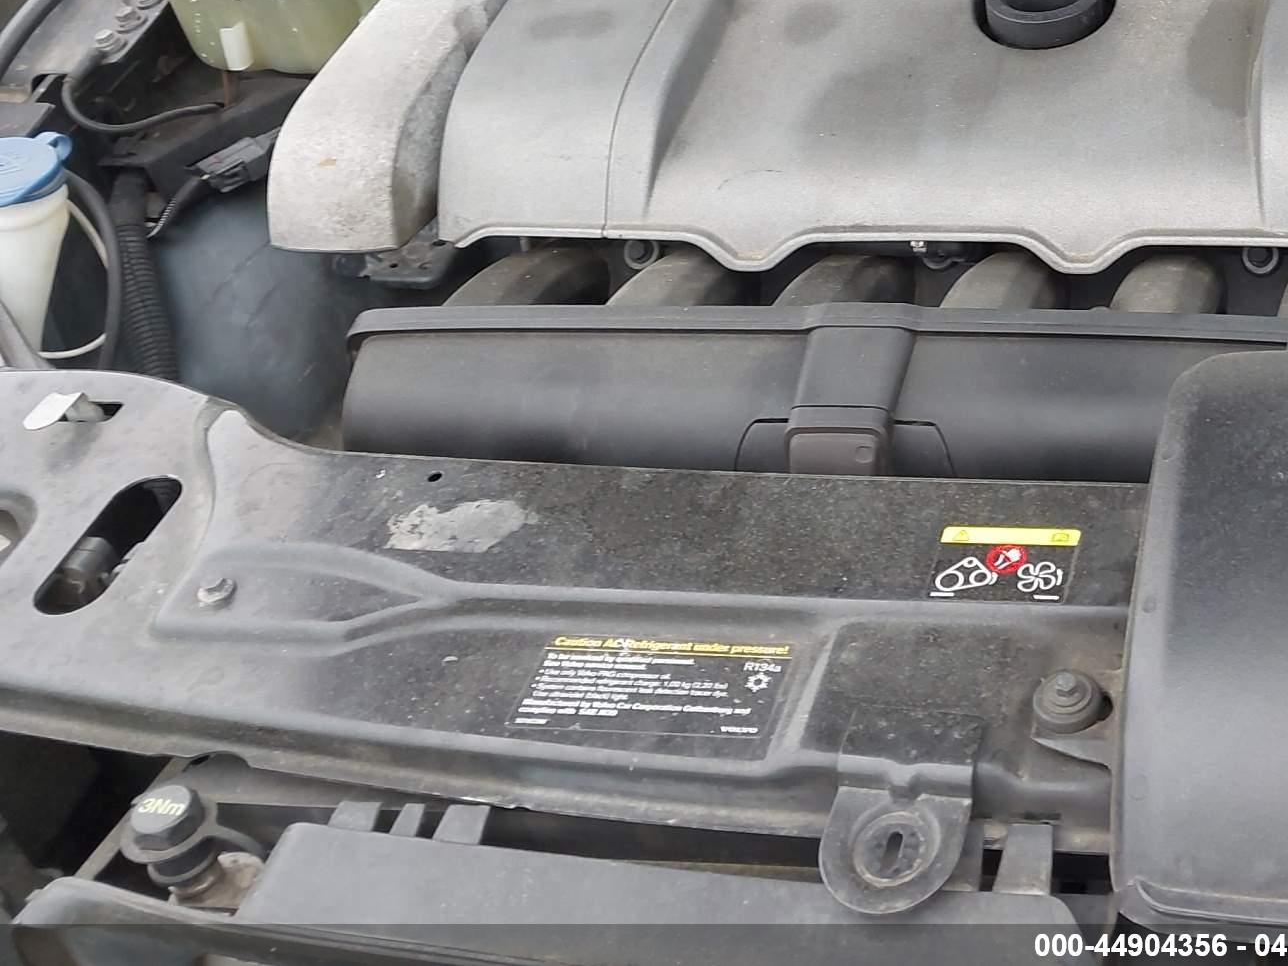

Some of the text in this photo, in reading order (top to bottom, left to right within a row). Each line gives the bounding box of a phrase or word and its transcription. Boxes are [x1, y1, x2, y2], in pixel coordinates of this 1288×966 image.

[554, 637, 602, 647] Caution
[693, 643, 730, 653] under
[730, 645, 790, 655] pressure!
[743, 661, 782, 673] R134a
[138, 797, 186, 816] 3Nm
